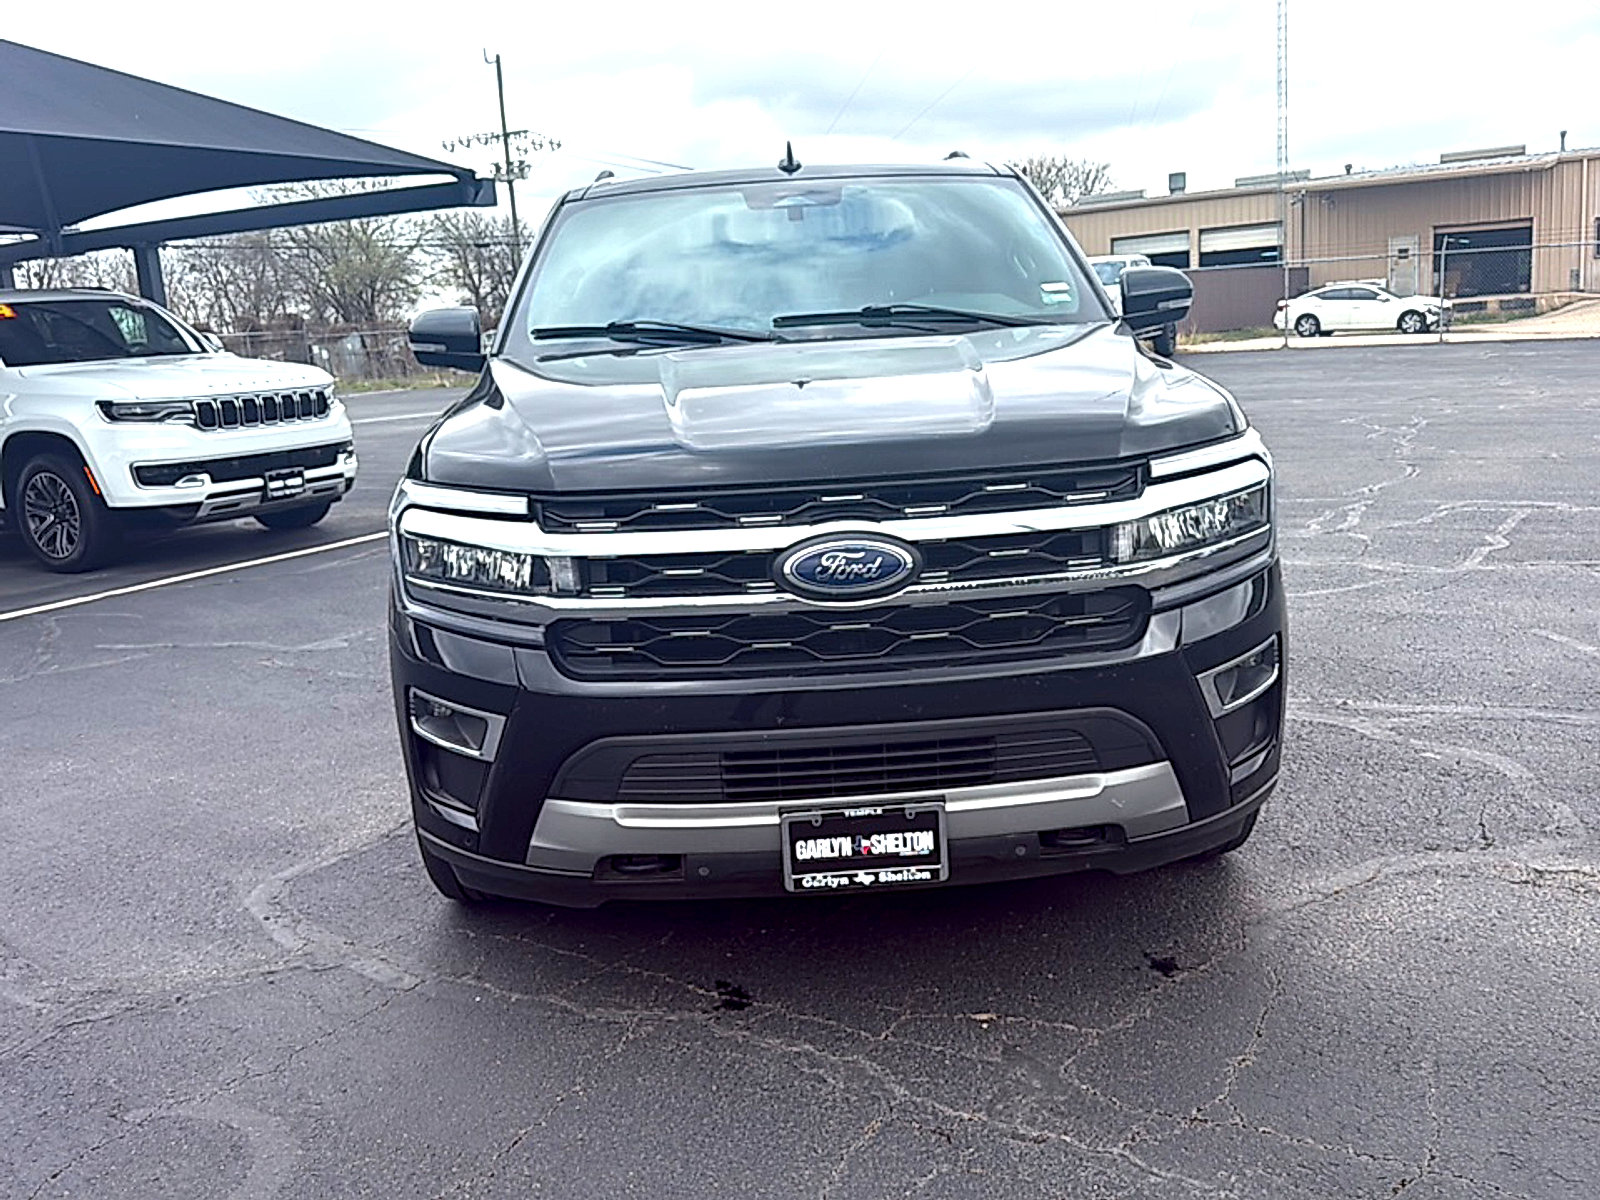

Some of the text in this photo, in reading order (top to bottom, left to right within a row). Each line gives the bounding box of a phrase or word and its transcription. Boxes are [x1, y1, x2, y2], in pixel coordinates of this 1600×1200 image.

[815, 551, 883, 580] Ford
[795, 830, 934, 860] GARLYN SHELTON
[878, 868, 932, 882] Shelton
